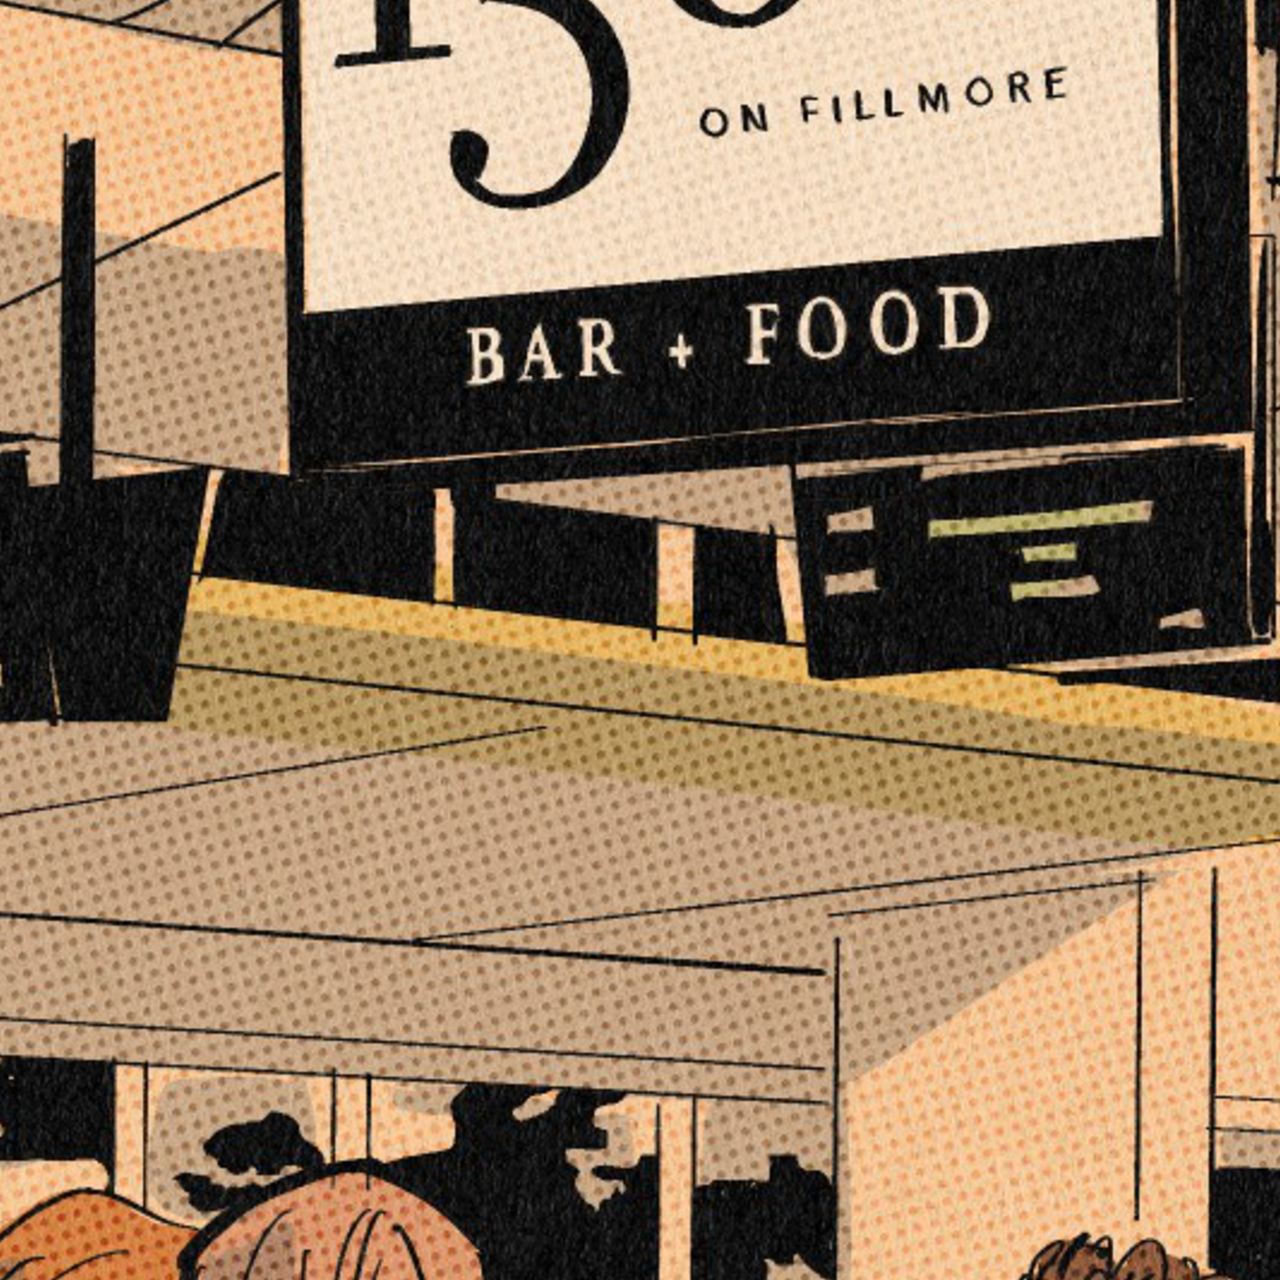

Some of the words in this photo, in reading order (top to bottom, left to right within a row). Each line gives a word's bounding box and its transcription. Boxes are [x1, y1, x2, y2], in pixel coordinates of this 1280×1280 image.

[698, 105, 769, 138] ON
[798, 66, 1070, 124] FILLMORE
[464, 317, 623, 388] BAR
[667, 332, 695, 370] +
[744, 285, 992, 367] FOOD
